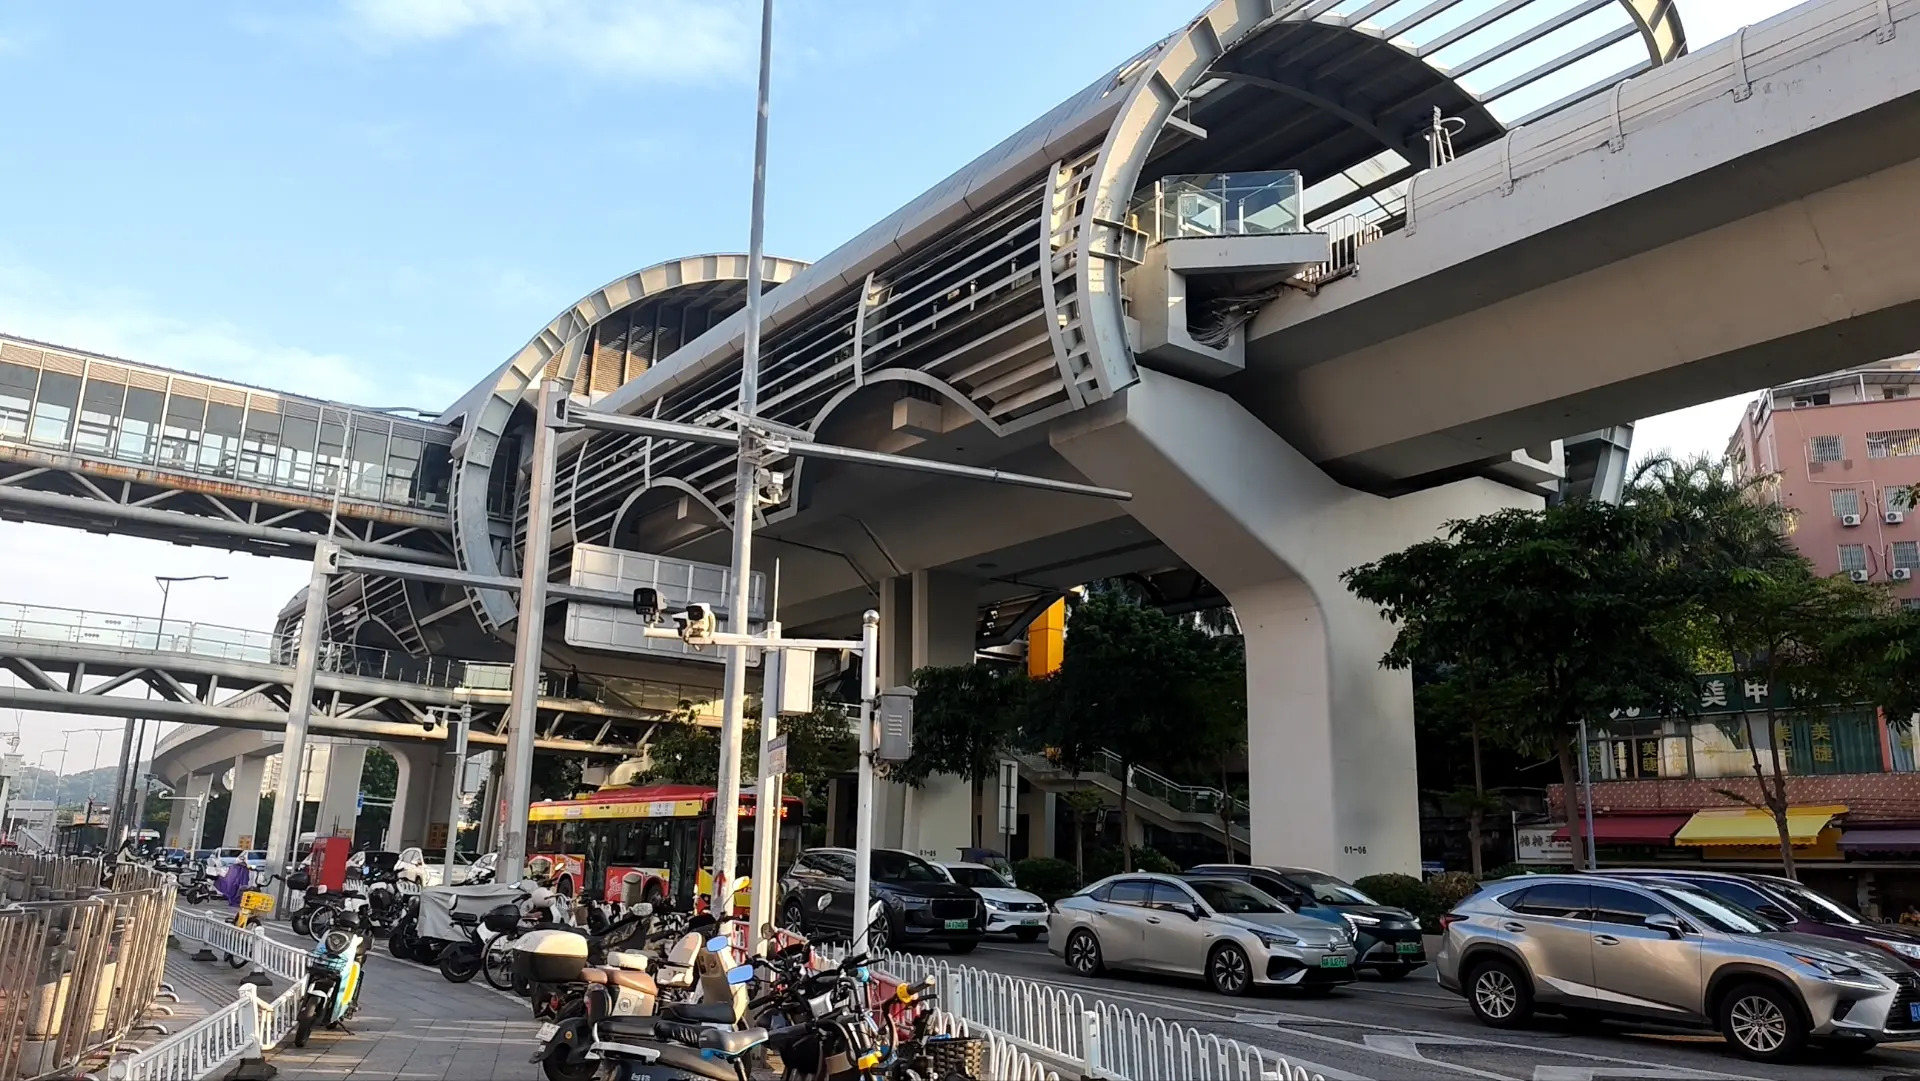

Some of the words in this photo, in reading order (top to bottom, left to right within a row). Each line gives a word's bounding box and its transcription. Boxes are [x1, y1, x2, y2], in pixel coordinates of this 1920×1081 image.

[1642, 741, 1657, 771] 美睫
[1811, 722, 1833, 762] 美睫
[1344, 846, 1367, 854] 01-06
